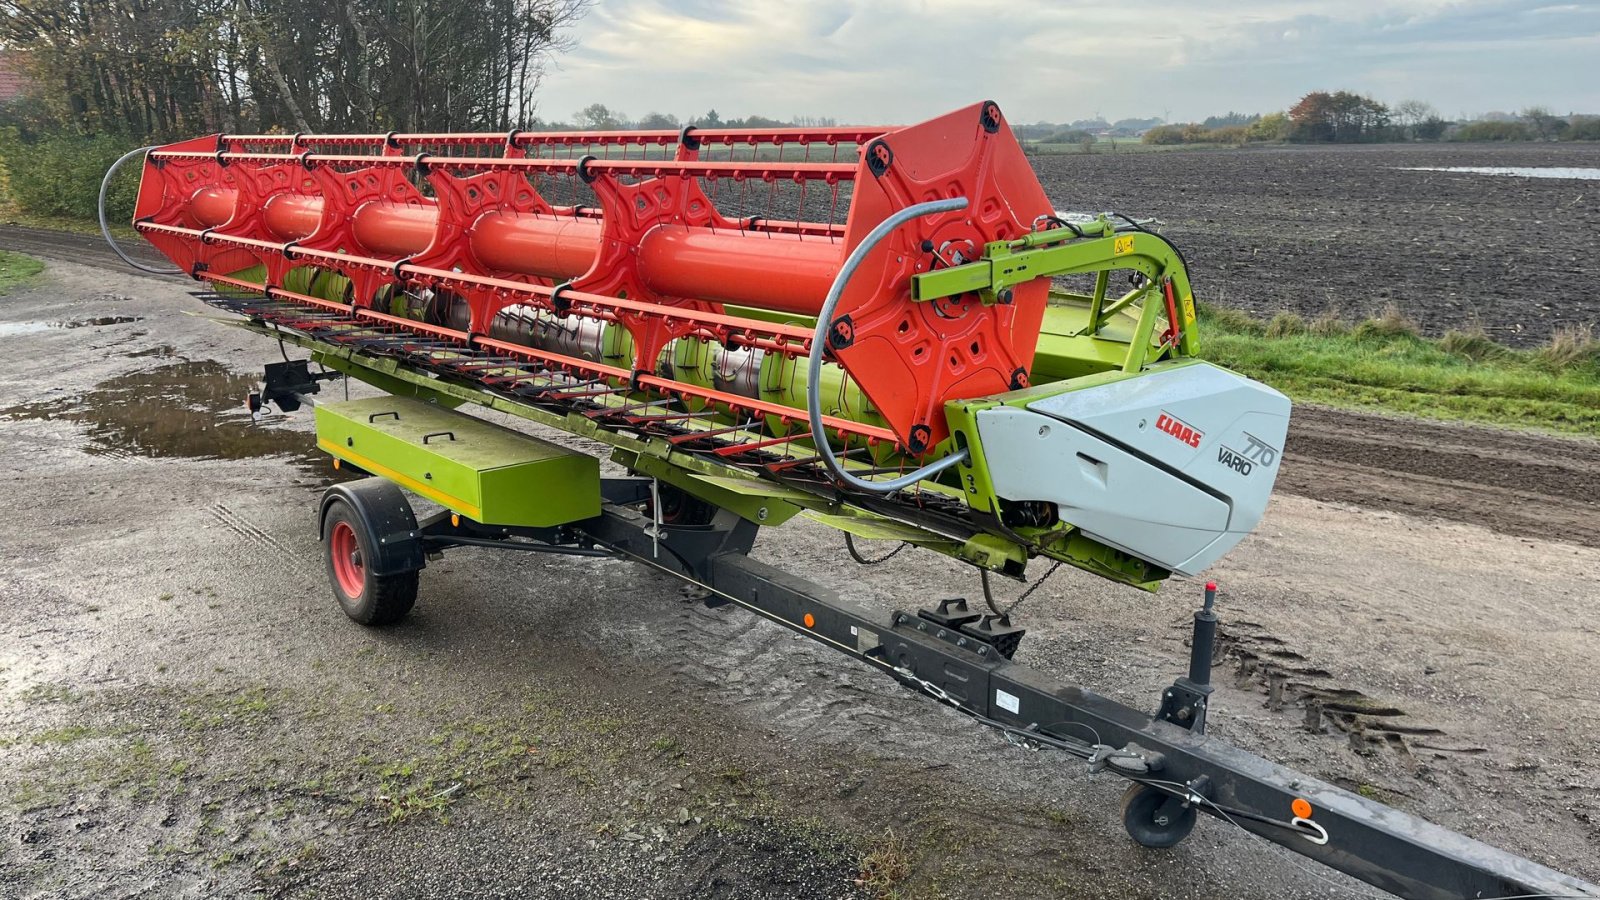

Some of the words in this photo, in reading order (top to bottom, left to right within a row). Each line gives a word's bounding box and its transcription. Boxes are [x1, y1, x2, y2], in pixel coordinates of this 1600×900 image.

[1155, 414, 1202, 449] CLAAS
[1217, 447, 1252, 476] VARIO
[1242, 436, 1275, 467] 770
